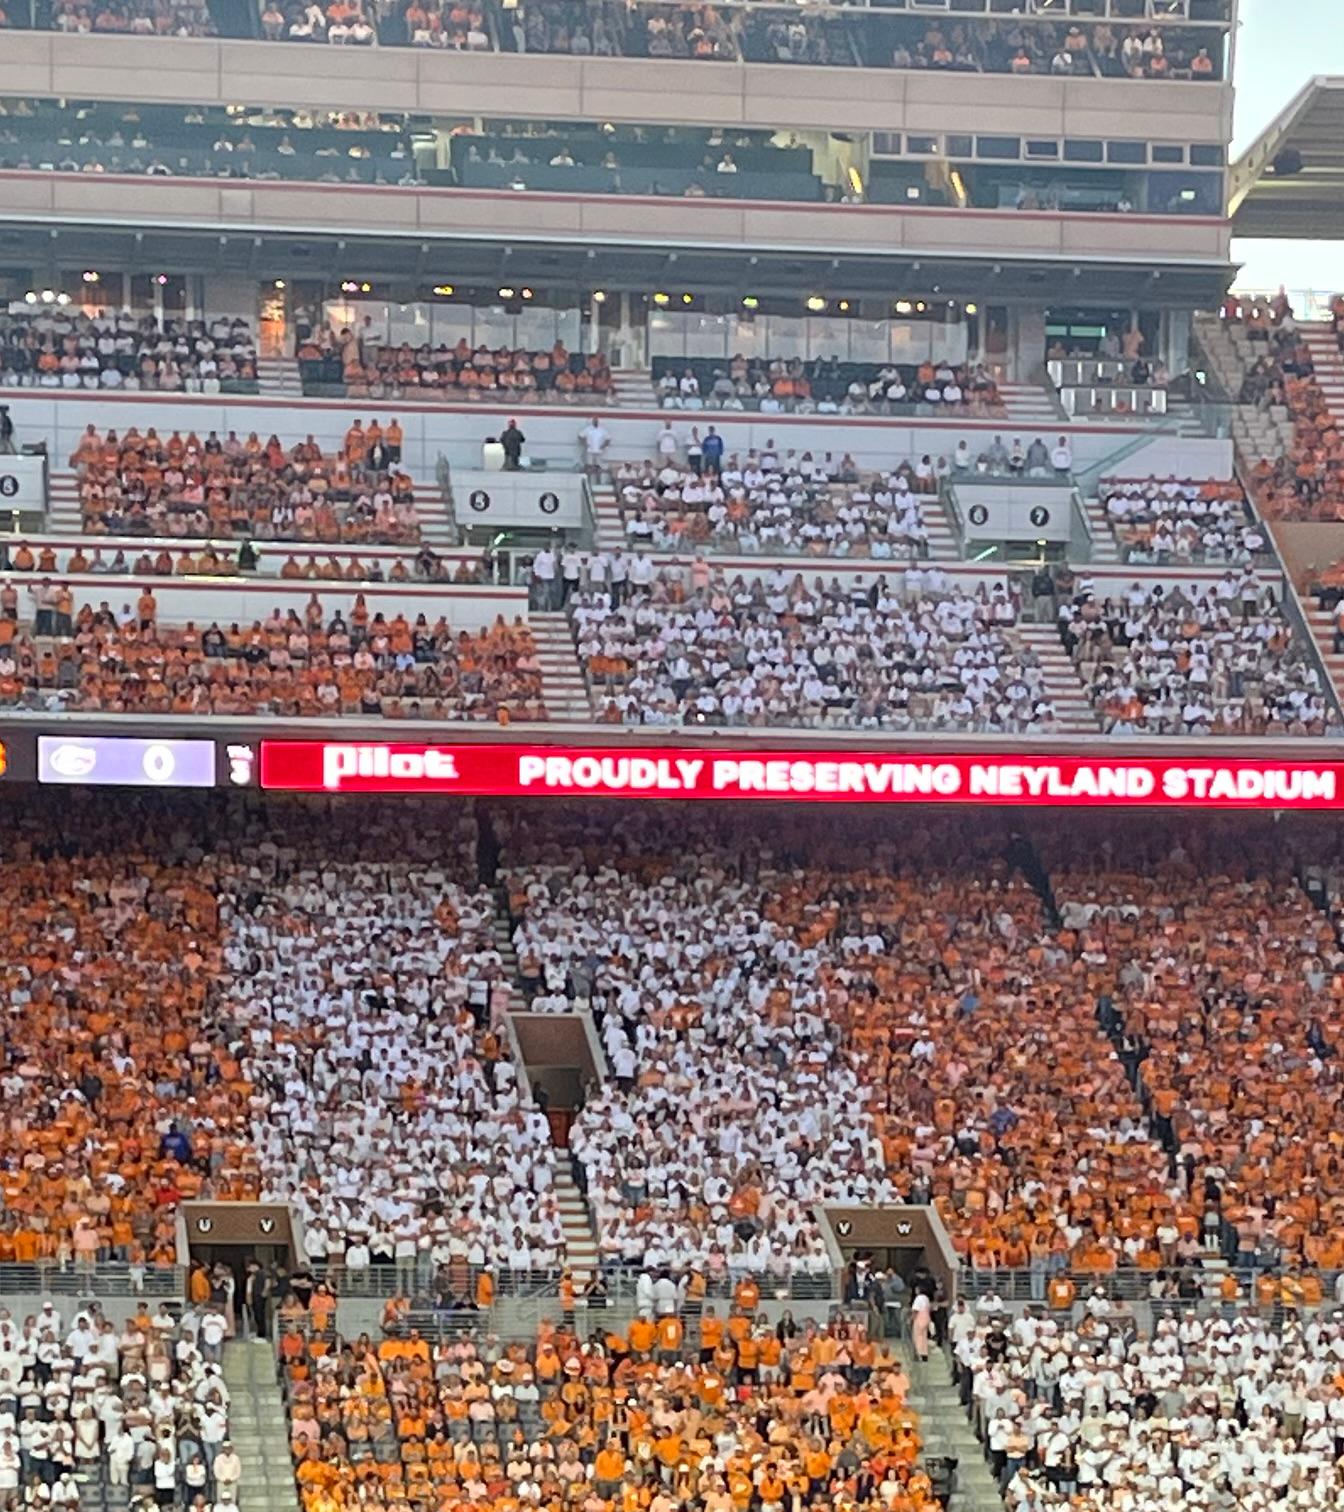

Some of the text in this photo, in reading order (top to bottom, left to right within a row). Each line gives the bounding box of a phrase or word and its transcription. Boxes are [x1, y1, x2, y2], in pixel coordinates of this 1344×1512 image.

[142, 744, 176, 782] 0
[518, 754, 1335, 799] PROUDLY PRESERVING NEYLAND STADIUM
